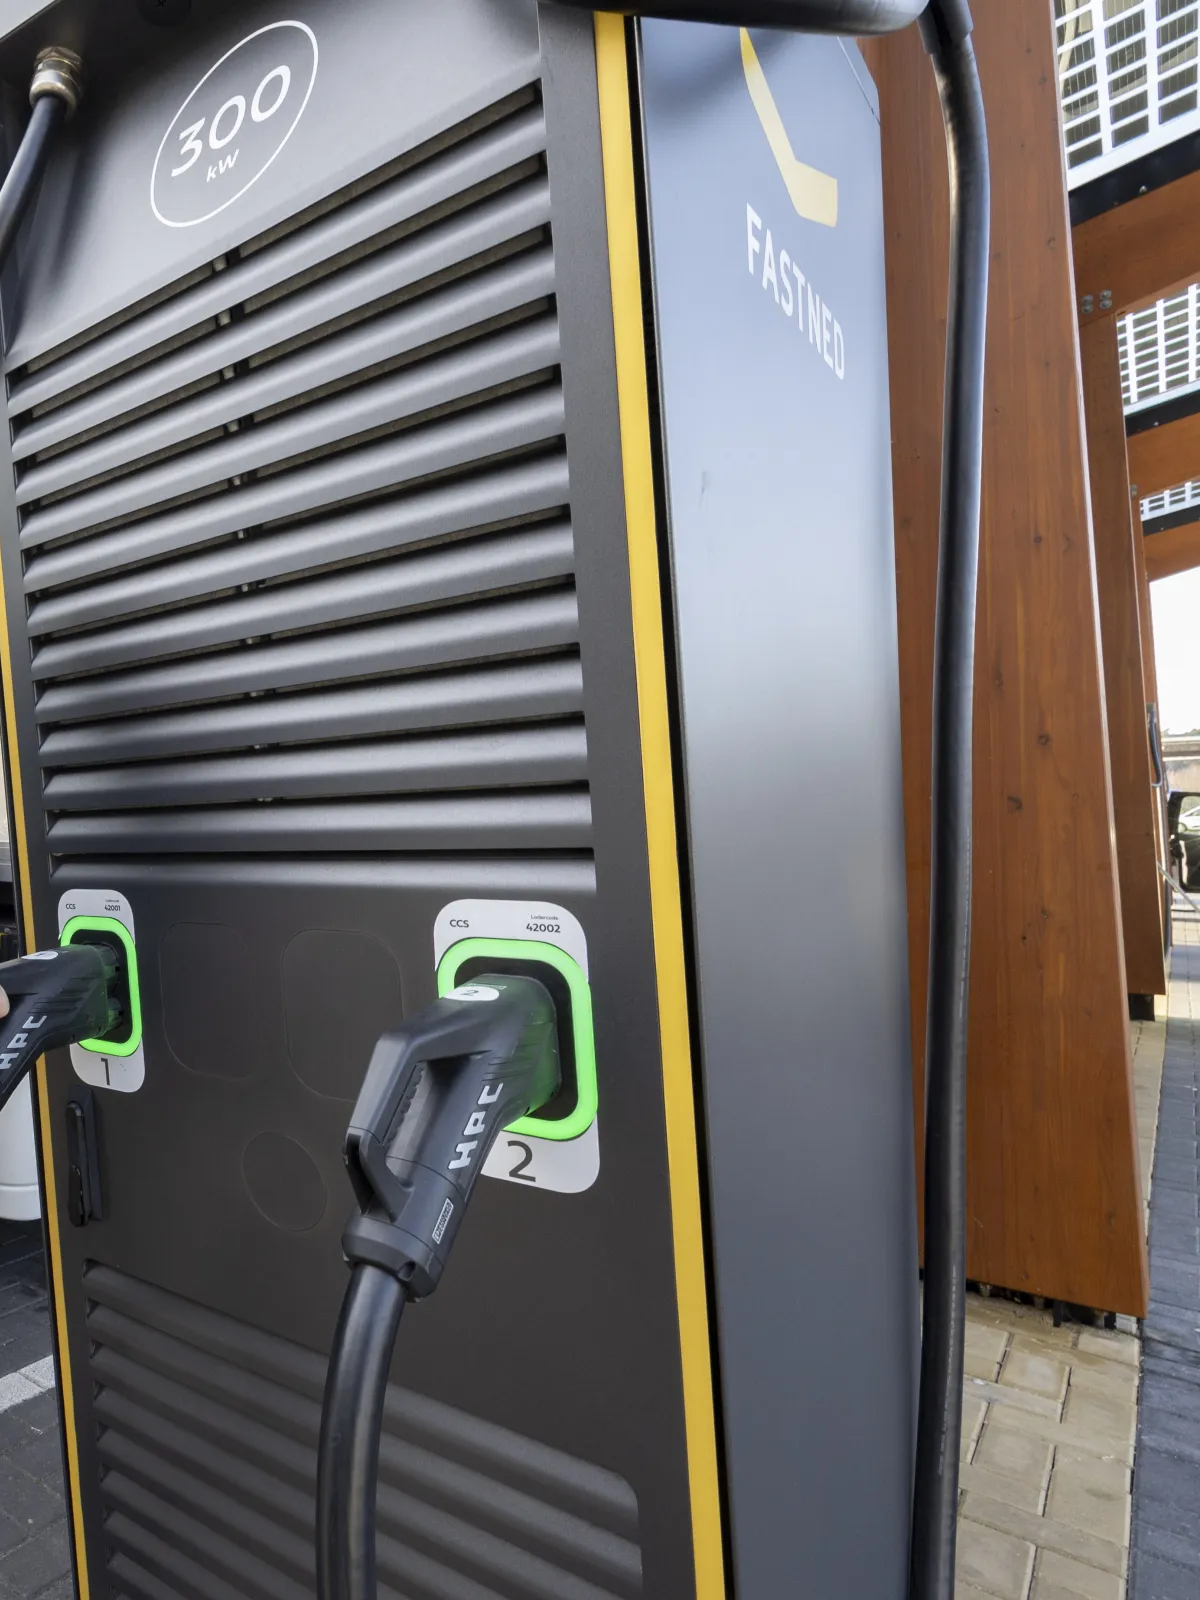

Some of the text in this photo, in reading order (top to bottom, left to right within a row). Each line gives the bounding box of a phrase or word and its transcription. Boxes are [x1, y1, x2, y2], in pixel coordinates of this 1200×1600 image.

[171, 65, 291, 177] 300
[206, 149, 239, 182] kW
[746, 202, 845, 380] FASTNED
[104, 904, 121, 912] 42001
[449, 919, 469, 928] CCS
[526, 923, 561, 933] 42002
[100, 1057, 111, 1086] 1
[448, 1082, 504, 1169] HPC
[506, 1140, 536, 1183] 2
